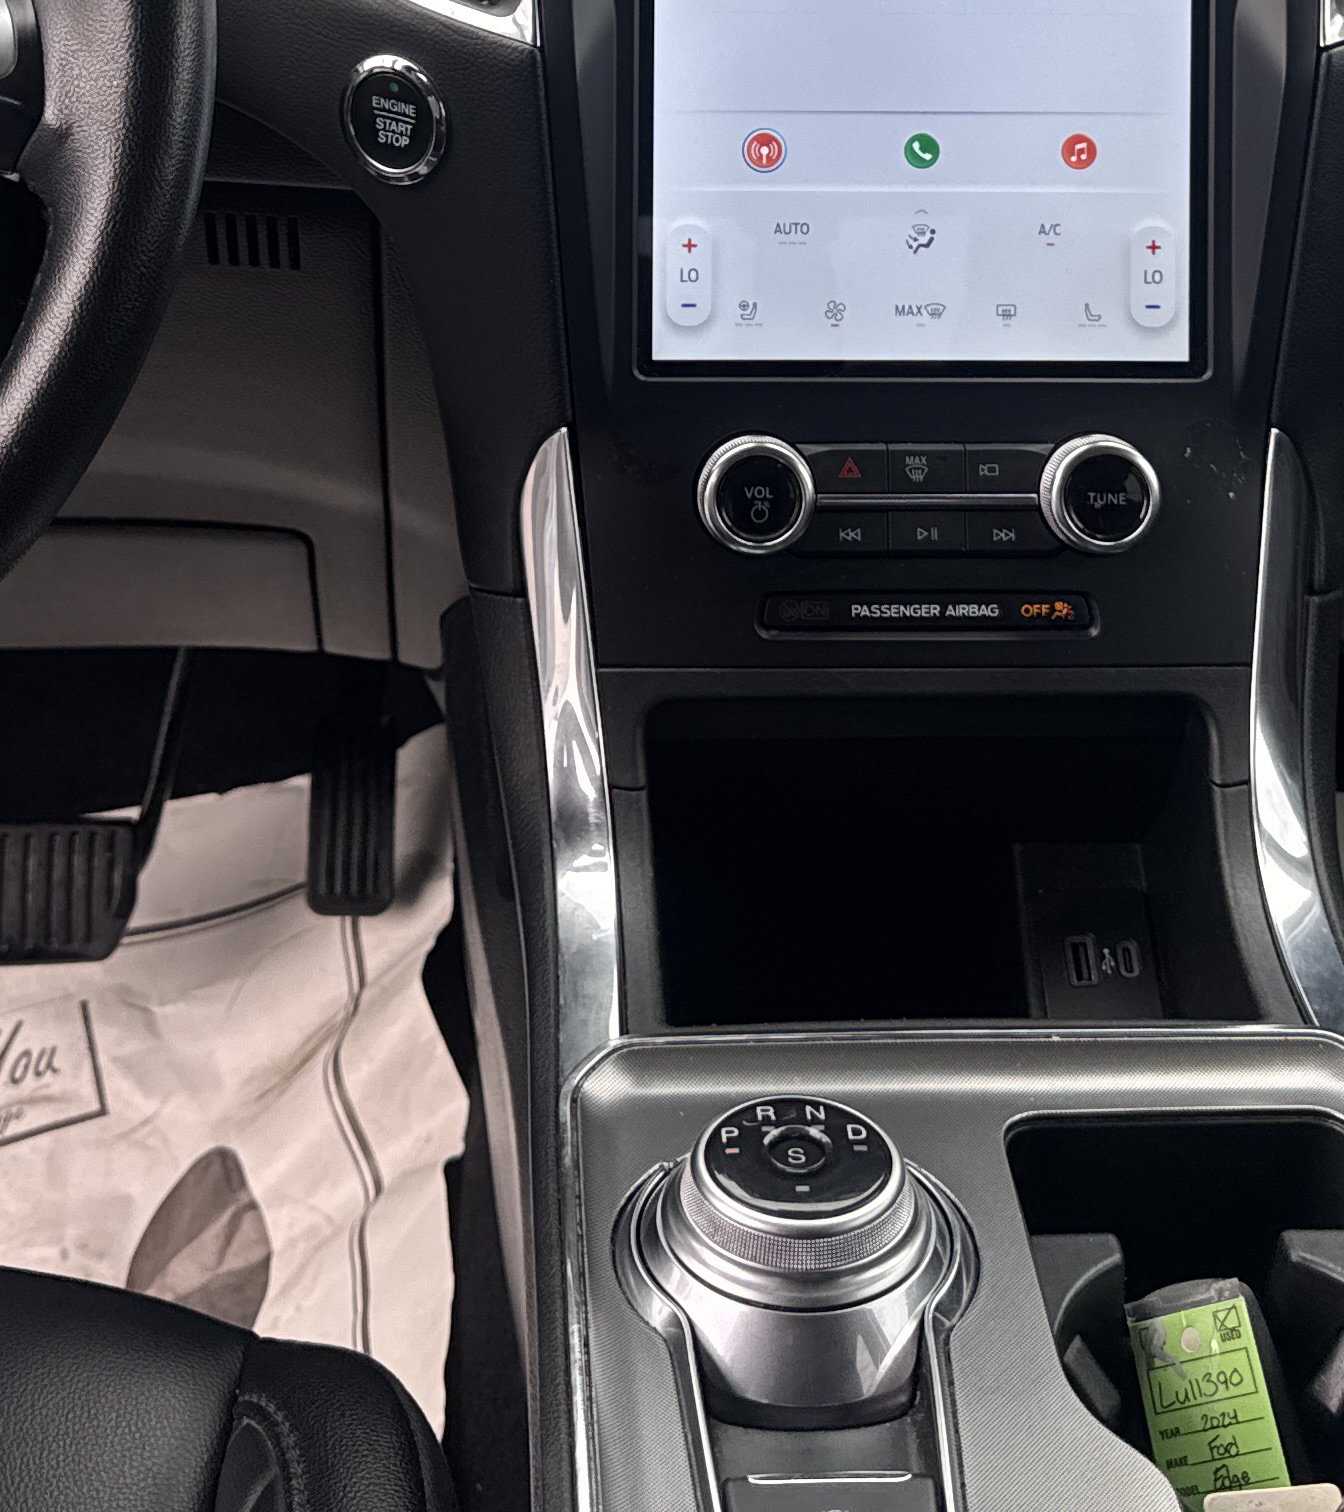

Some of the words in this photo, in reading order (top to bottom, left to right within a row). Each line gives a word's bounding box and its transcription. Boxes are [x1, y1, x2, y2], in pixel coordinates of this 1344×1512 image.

[372, 96, 417, 118] ENGINE
[375, 117, 413, 136] START
[377, 131, 410, 148] STOP
[774, 222, 810, 236] AUTO
[1038, 223, 1061, 237] A/C
[679, 268, 699, 283] LO
[1143, 270, 1164, 285] LO
[894, 304, 923, 317] MAX
[905, 456, 928, 466] MAX
[744, 487, 773, 499] VOL
[1088, 492, 1127, 505] TUNE
[851, 604, 940, 618] PASSENGER
[945, 604, 999, 618] AIRBAG
[1020, 604, 1051, 618] OFF
[756, 1106, 776, 1121] R
[806, 1105, 826, 1120] N
[721, 1127, 739, 1143] P
[847, 1124, 867, 1141] D
[787, 1147, 806, 1164] S
[1201, 1408, 1240, 1431] 2024
[1213, 1464, 1250, 1491] Edge
